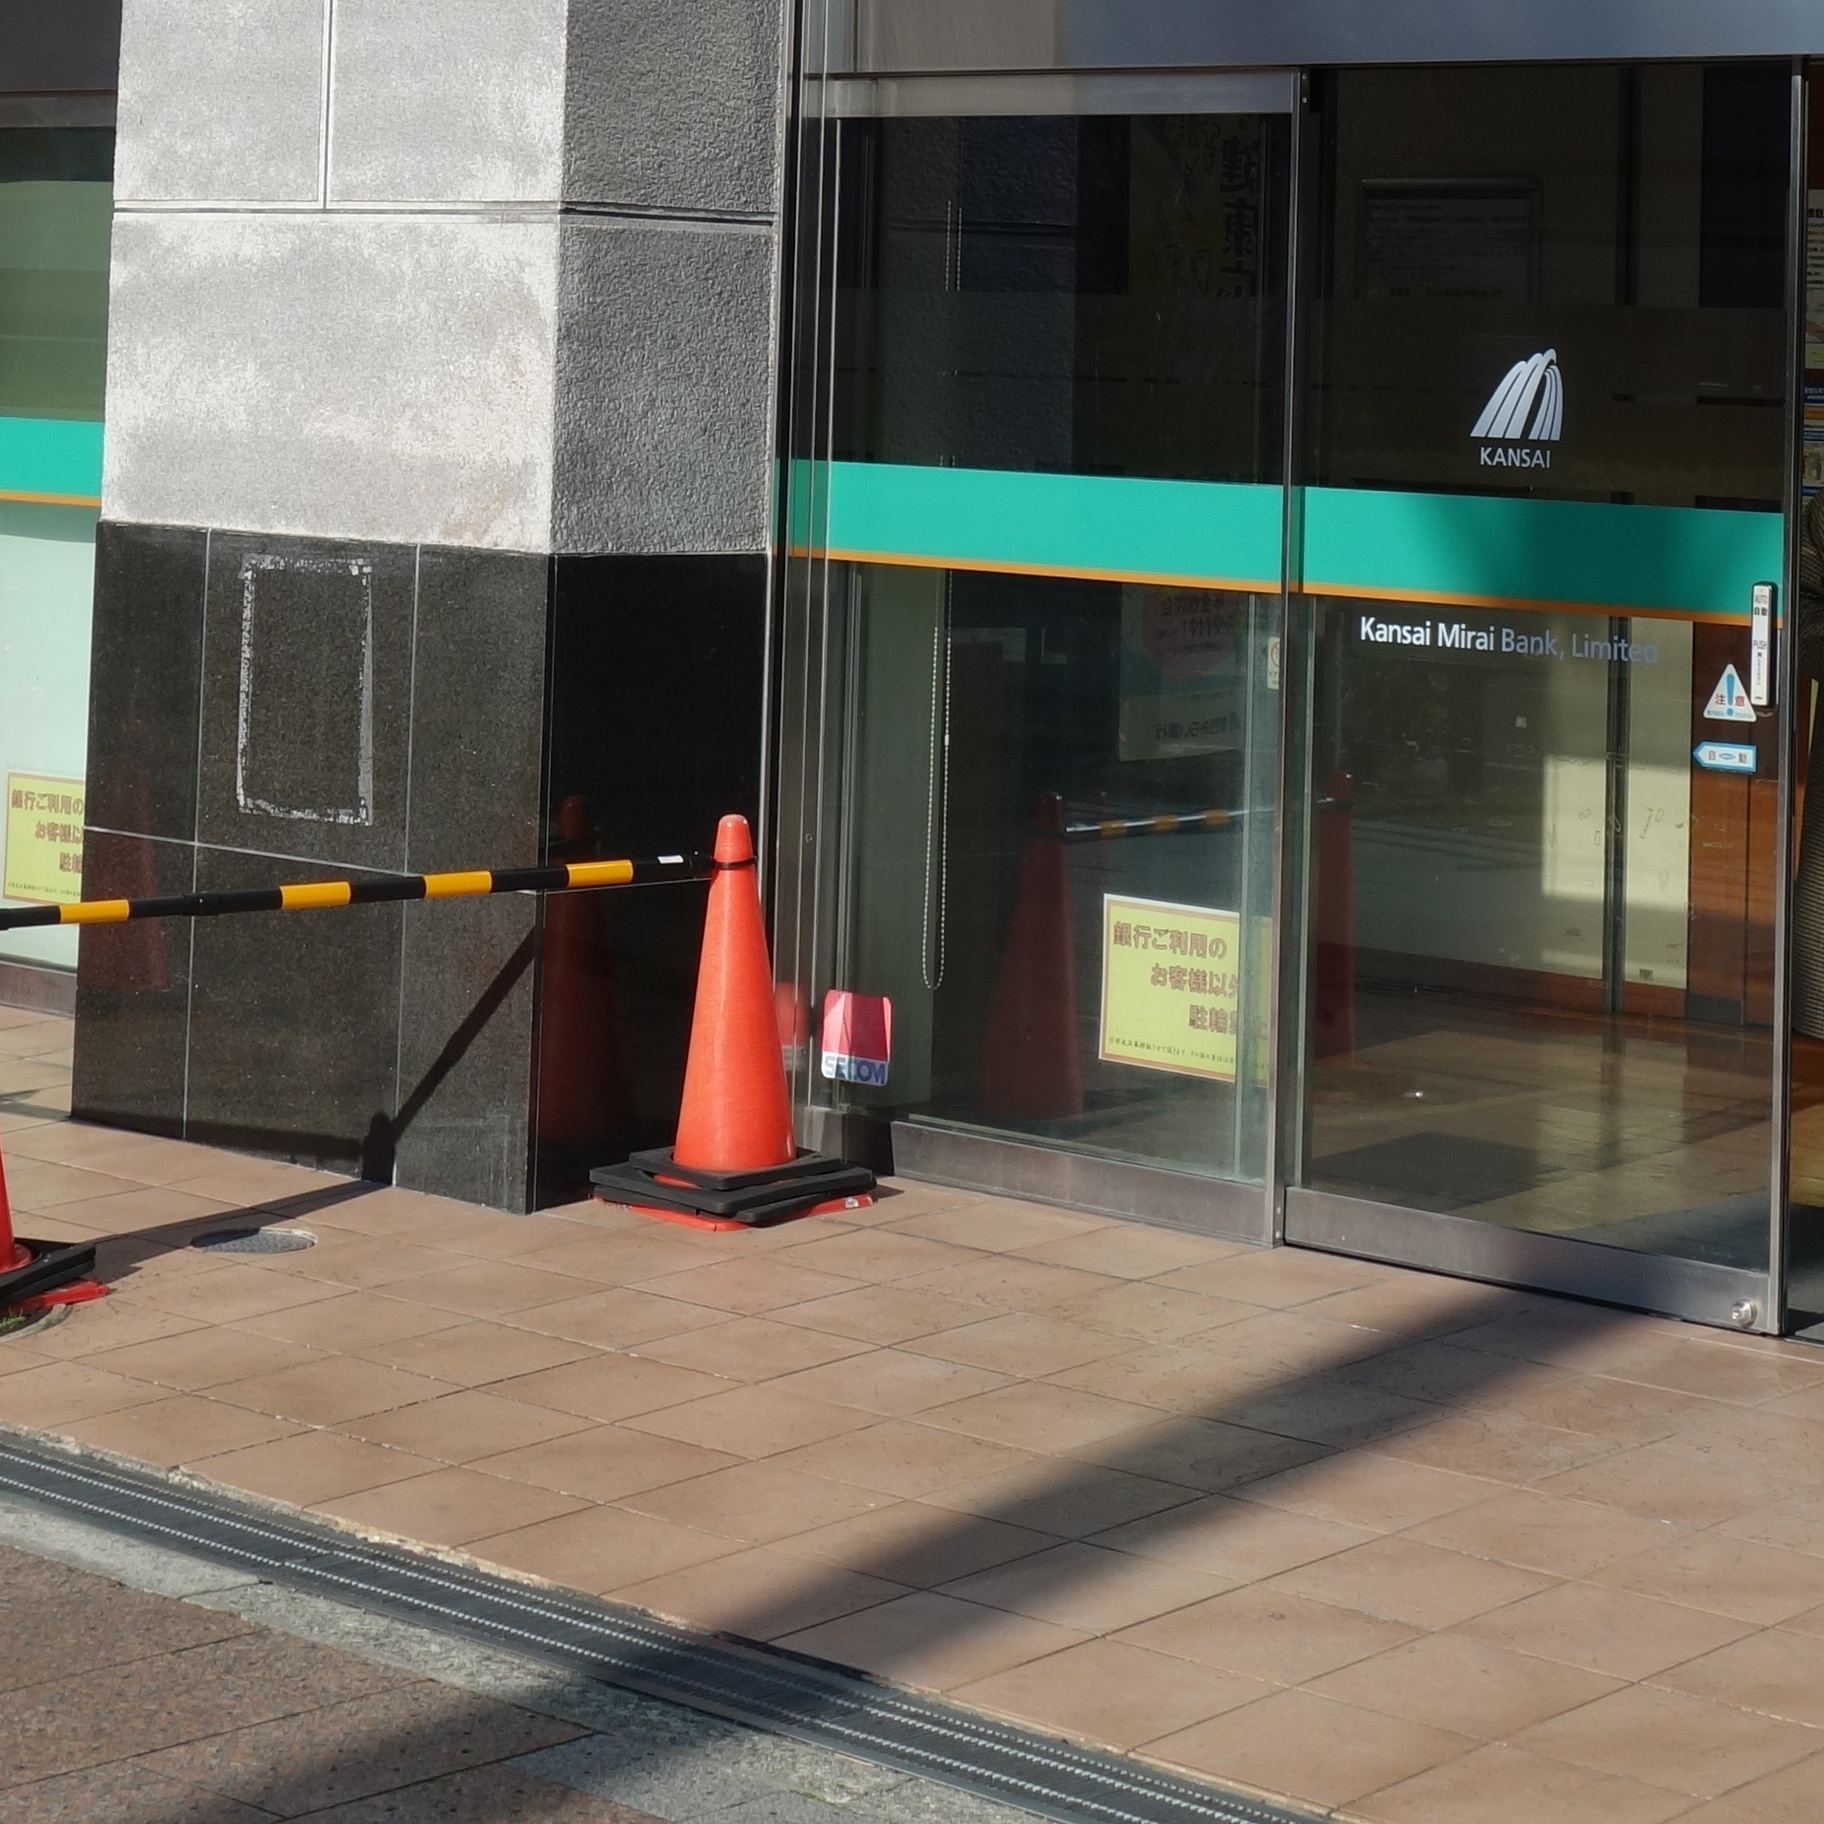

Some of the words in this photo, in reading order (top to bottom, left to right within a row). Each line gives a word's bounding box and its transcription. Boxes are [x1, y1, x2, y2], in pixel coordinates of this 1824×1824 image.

[1479, 446, 1552, 469] KANSAI
[1360, 616, 1431, 646] Kansai
[1437, 622, 1495, 651] Mirai
[1500, 627, 1566, 660] Bank,
[1571, 633, 1658, 664] Limited
[1714, 693, 1746, 707] 注意
[1708, 749, 1748, 764] 自動
[11, 788, 84, 816] 銀行ご利用の
[1113, 920, 1228, 960] 銀行ご利用の
[824, 1055, 887, 1085] SECOM
